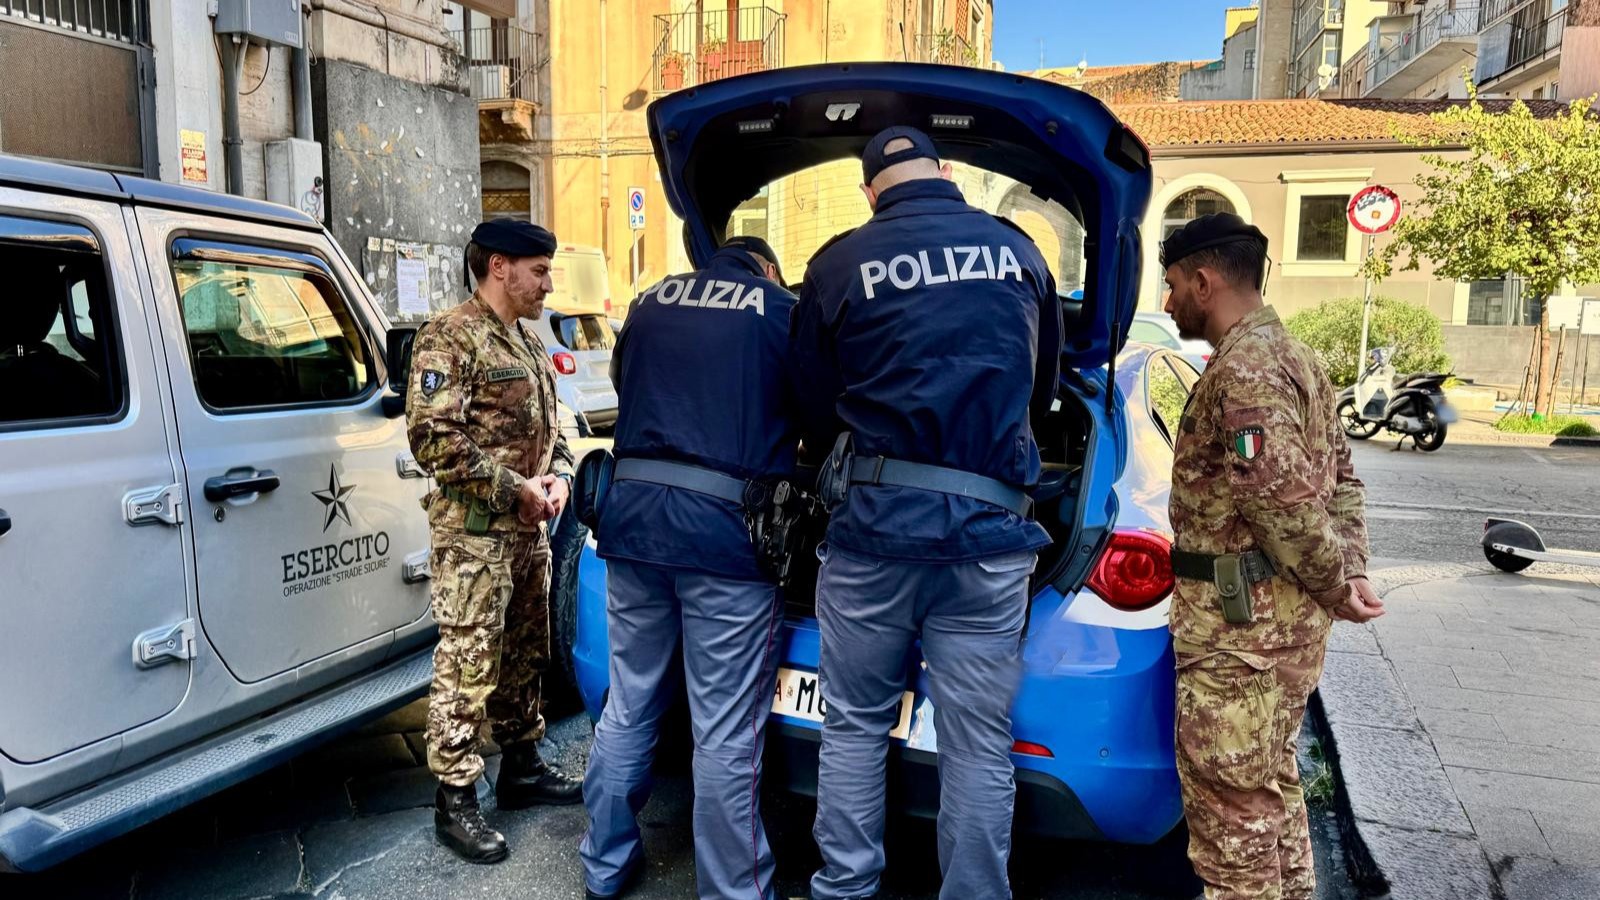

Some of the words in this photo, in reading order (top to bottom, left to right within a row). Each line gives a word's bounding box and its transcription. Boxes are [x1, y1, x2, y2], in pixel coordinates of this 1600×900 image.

[859, 246, 1022, 300] POLIZIA
[638, 278, 765, 316] POLIZIA
[491, 369, 524, 379] ESERCITO
[281, 531, 390, 583] ESERCITO
[283, 574, 331, 597] OPERAZIONE
[332, 565, 363, 582] "STRADE
[363, 557, 390, 574] SICURE"
